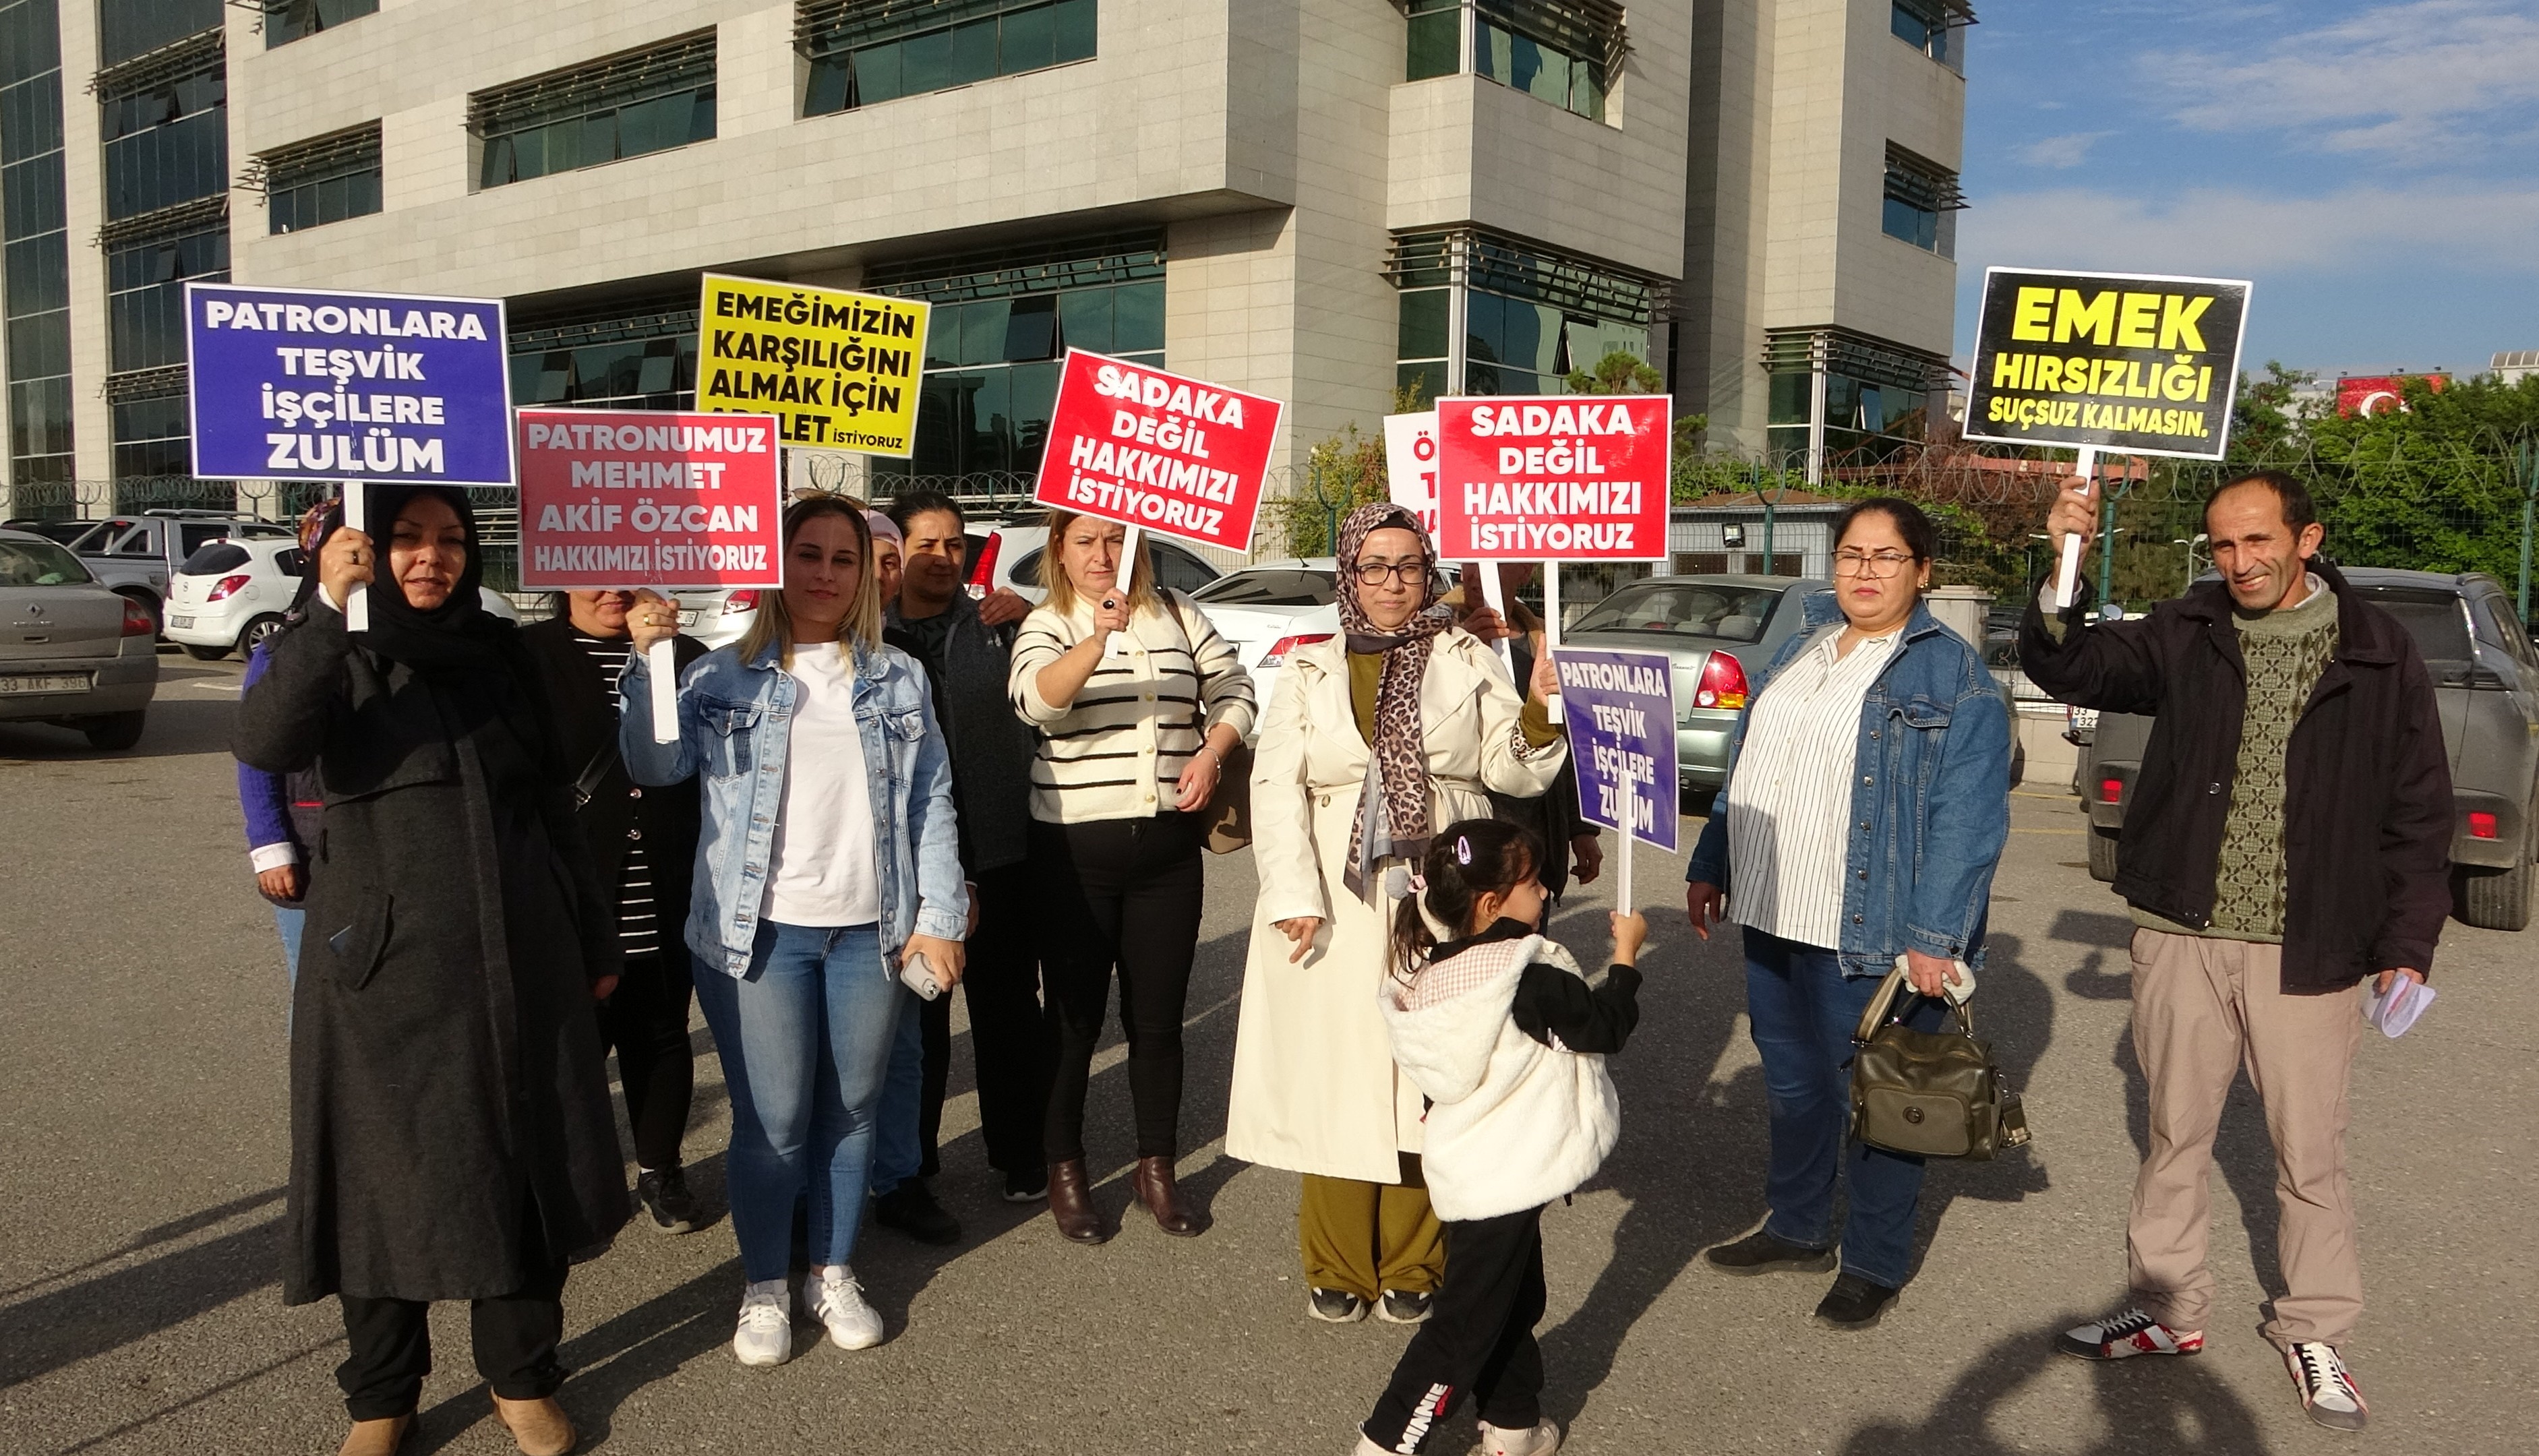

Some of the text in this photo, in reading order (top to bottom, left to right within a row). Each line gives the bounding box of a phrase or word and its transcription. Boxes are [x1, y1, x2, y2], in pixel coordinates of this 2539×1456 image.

[206, 301, 487, 341] PATRONLARA
[717, 291, 915, 339] EMEĞİMİZİN
[2012, 286, 2214, 352] EMEK
[276, 344, 425, 385] TEŞVİK
[713, 329, 911, 378] KARŞILIĞINI
[709, 369, 901, 417] ALMAK İÇİN
[1094, 365, 1243, 429] SADAKA
[1992, 353, 2213, 403] HIRSIZLIĞI
[262, 382, 445, 428] İŞÇİLERE
[1470, 404, 1635, 437] SADAKA
[1988, 396, 2209, 438] SUÇSUZ KALMASIN.
[266, 428, 444, 473] ZULÜM
[529, 423, 767, 454] PATRONUMUZ
[713, 407, 903, 450] LET İSTİYORUZ
[1111, 409, 1209, 458] DEĞİL
[571, 461, 726, 489] MEHMET
[1069, 435, 1238, 505] HAKKIMIZI
[1499, 438, 1605, 475] DEĞİL
[538, 497, 758, 533] AKİF ÖZCAN
[1067, 468, 1224, 536] İSTİYORUZ
[1464, 481, 1641, 515] HAKKIMIZI
[535, 538, 767, 572] HAKKIMIZI İSTİYORUZ
[1470, 516, 1634, 550] İSTİYORUZ
[1559, 661, 1667, 698] PATRONLARA
[1592, 701, 1647, 740] TEŞVİK
[1592, 737, 1654, 785] İŞÇİLERE
[1599, 784, 1654, 834] ZUÜM
[1396, 1383, 1449, 1455] MINNIE
